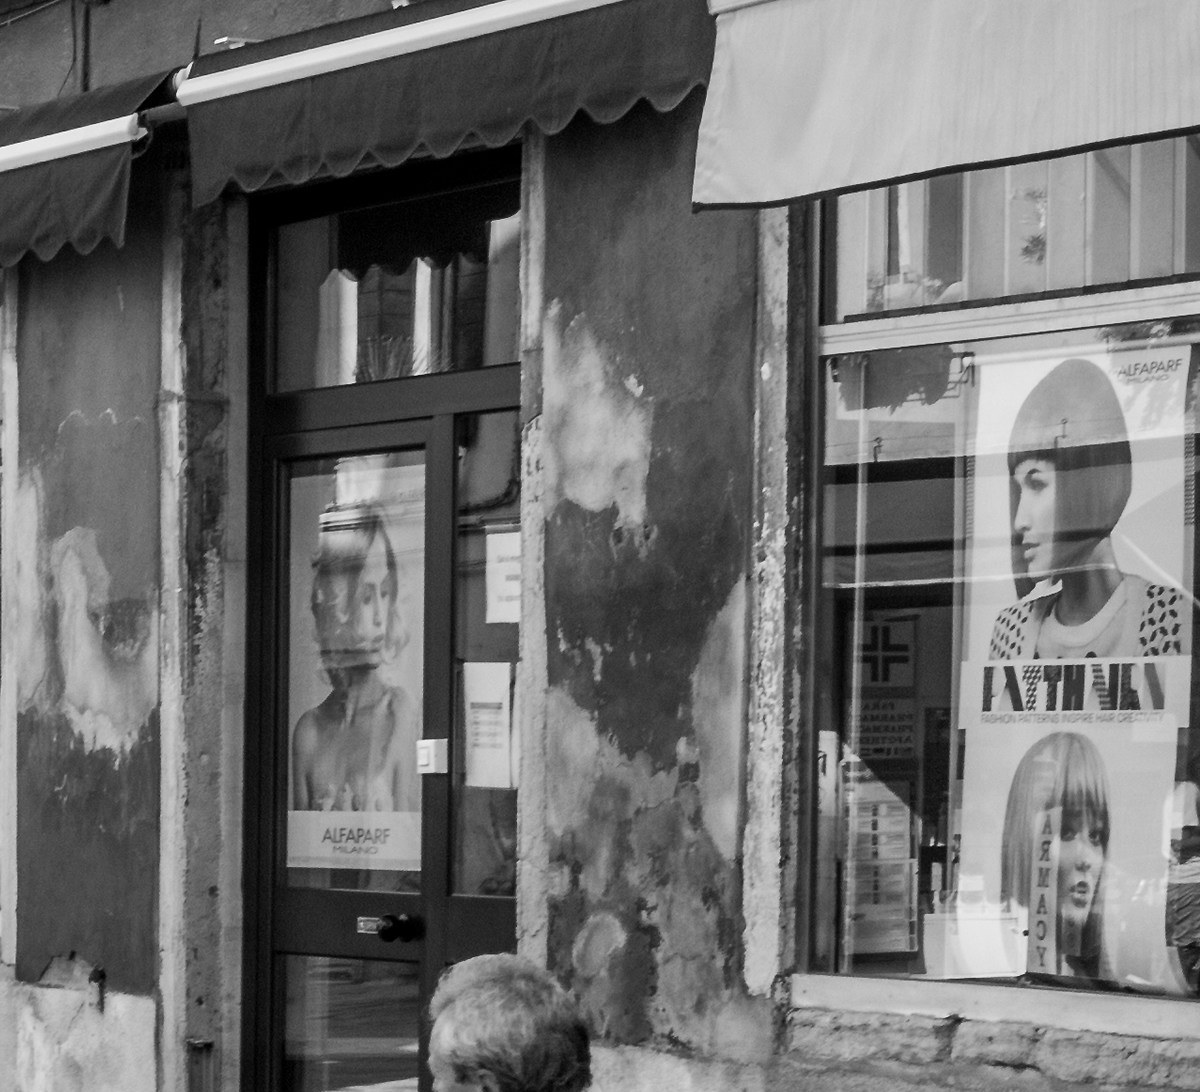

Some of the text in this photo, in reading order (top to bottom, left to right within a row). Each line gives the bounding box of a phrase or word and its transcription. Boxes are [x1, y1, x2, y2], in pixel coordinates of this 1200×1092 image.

[1118, 358, 1182, 377] ALFAPARF
[980, 712, 1017, 724] FASHION
[1018, 712, 1060, 724] PATTERNS
[321, 827, 391, 845] ALFAPARF
[332, 845, 379, 855] MILANO
